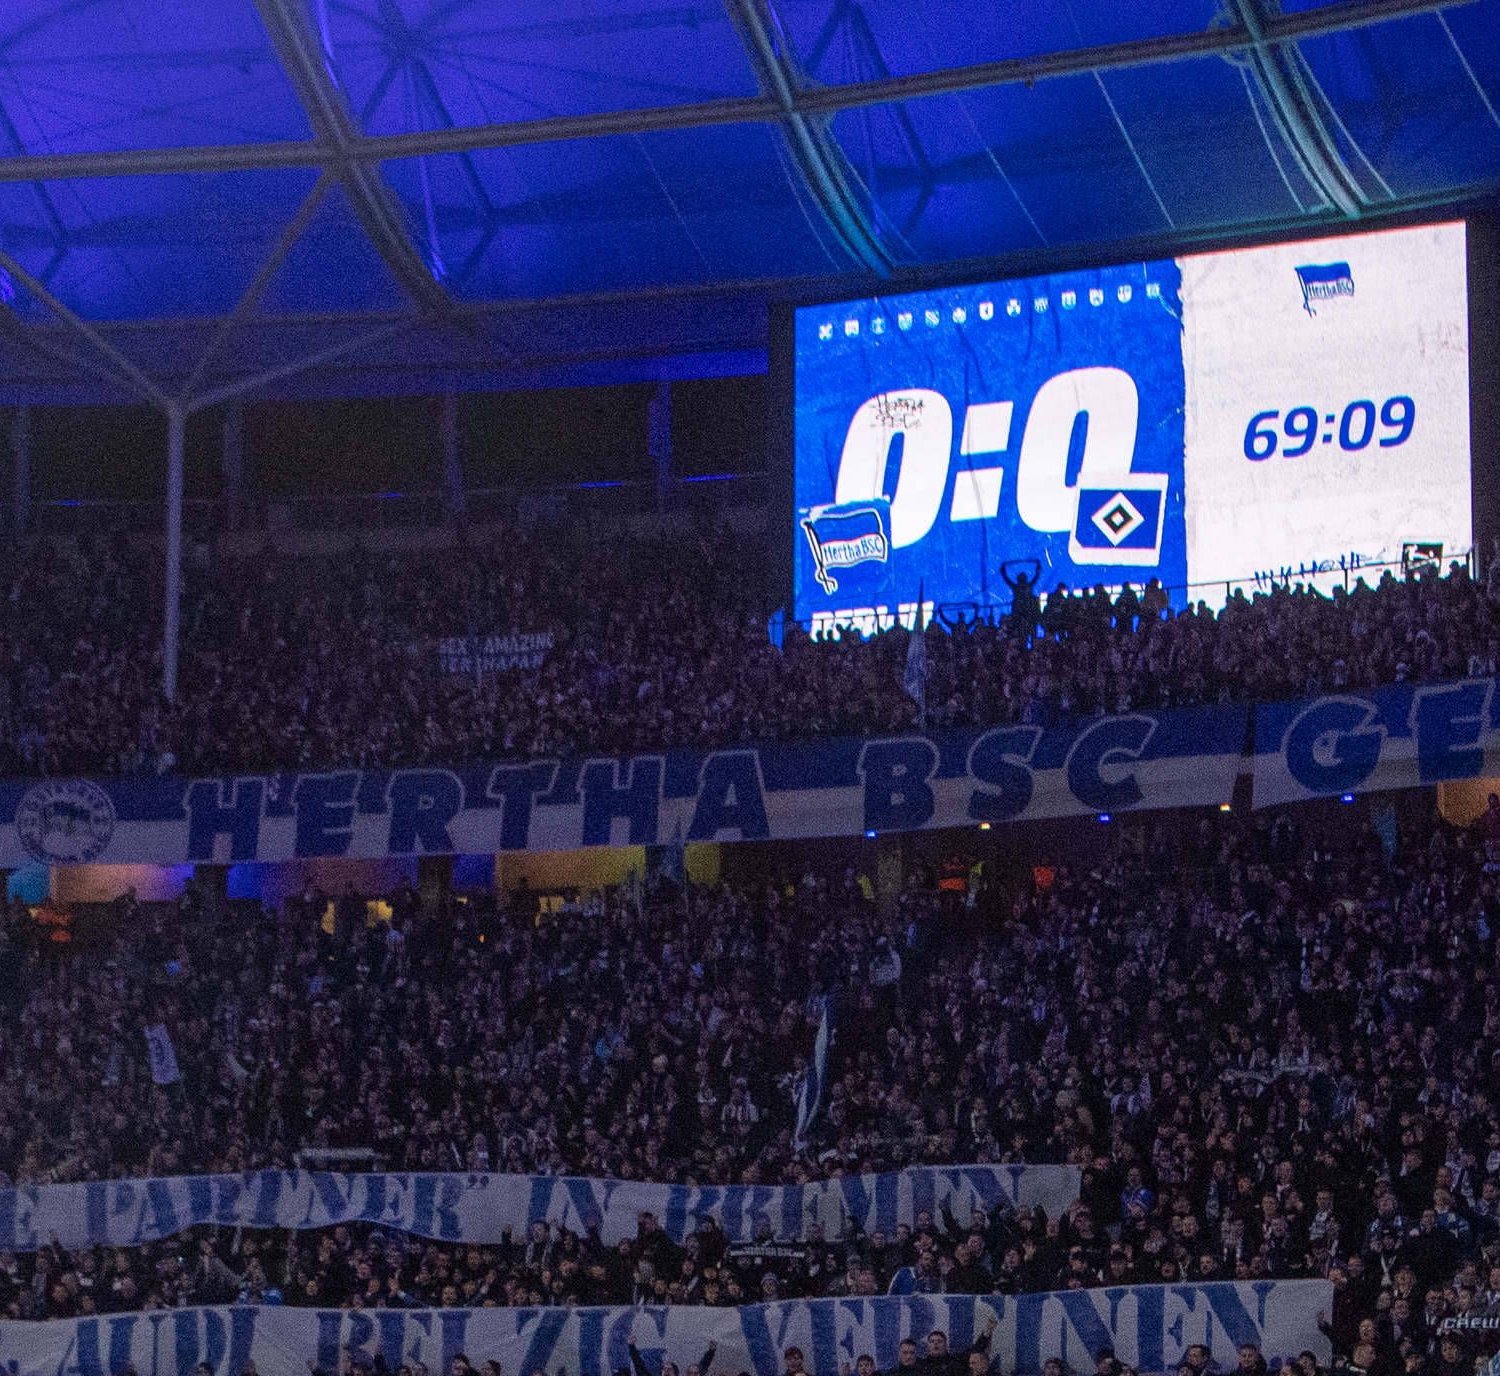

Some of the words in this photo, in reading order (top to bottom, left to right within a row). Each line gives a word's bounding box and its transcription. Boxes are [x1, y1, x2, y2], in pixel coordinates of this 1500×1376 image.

[1243, 396, 1416, 462] 69:09
[183, 749, 771, 856] HERTHA
[855, 715, 1158, 836] BSC
